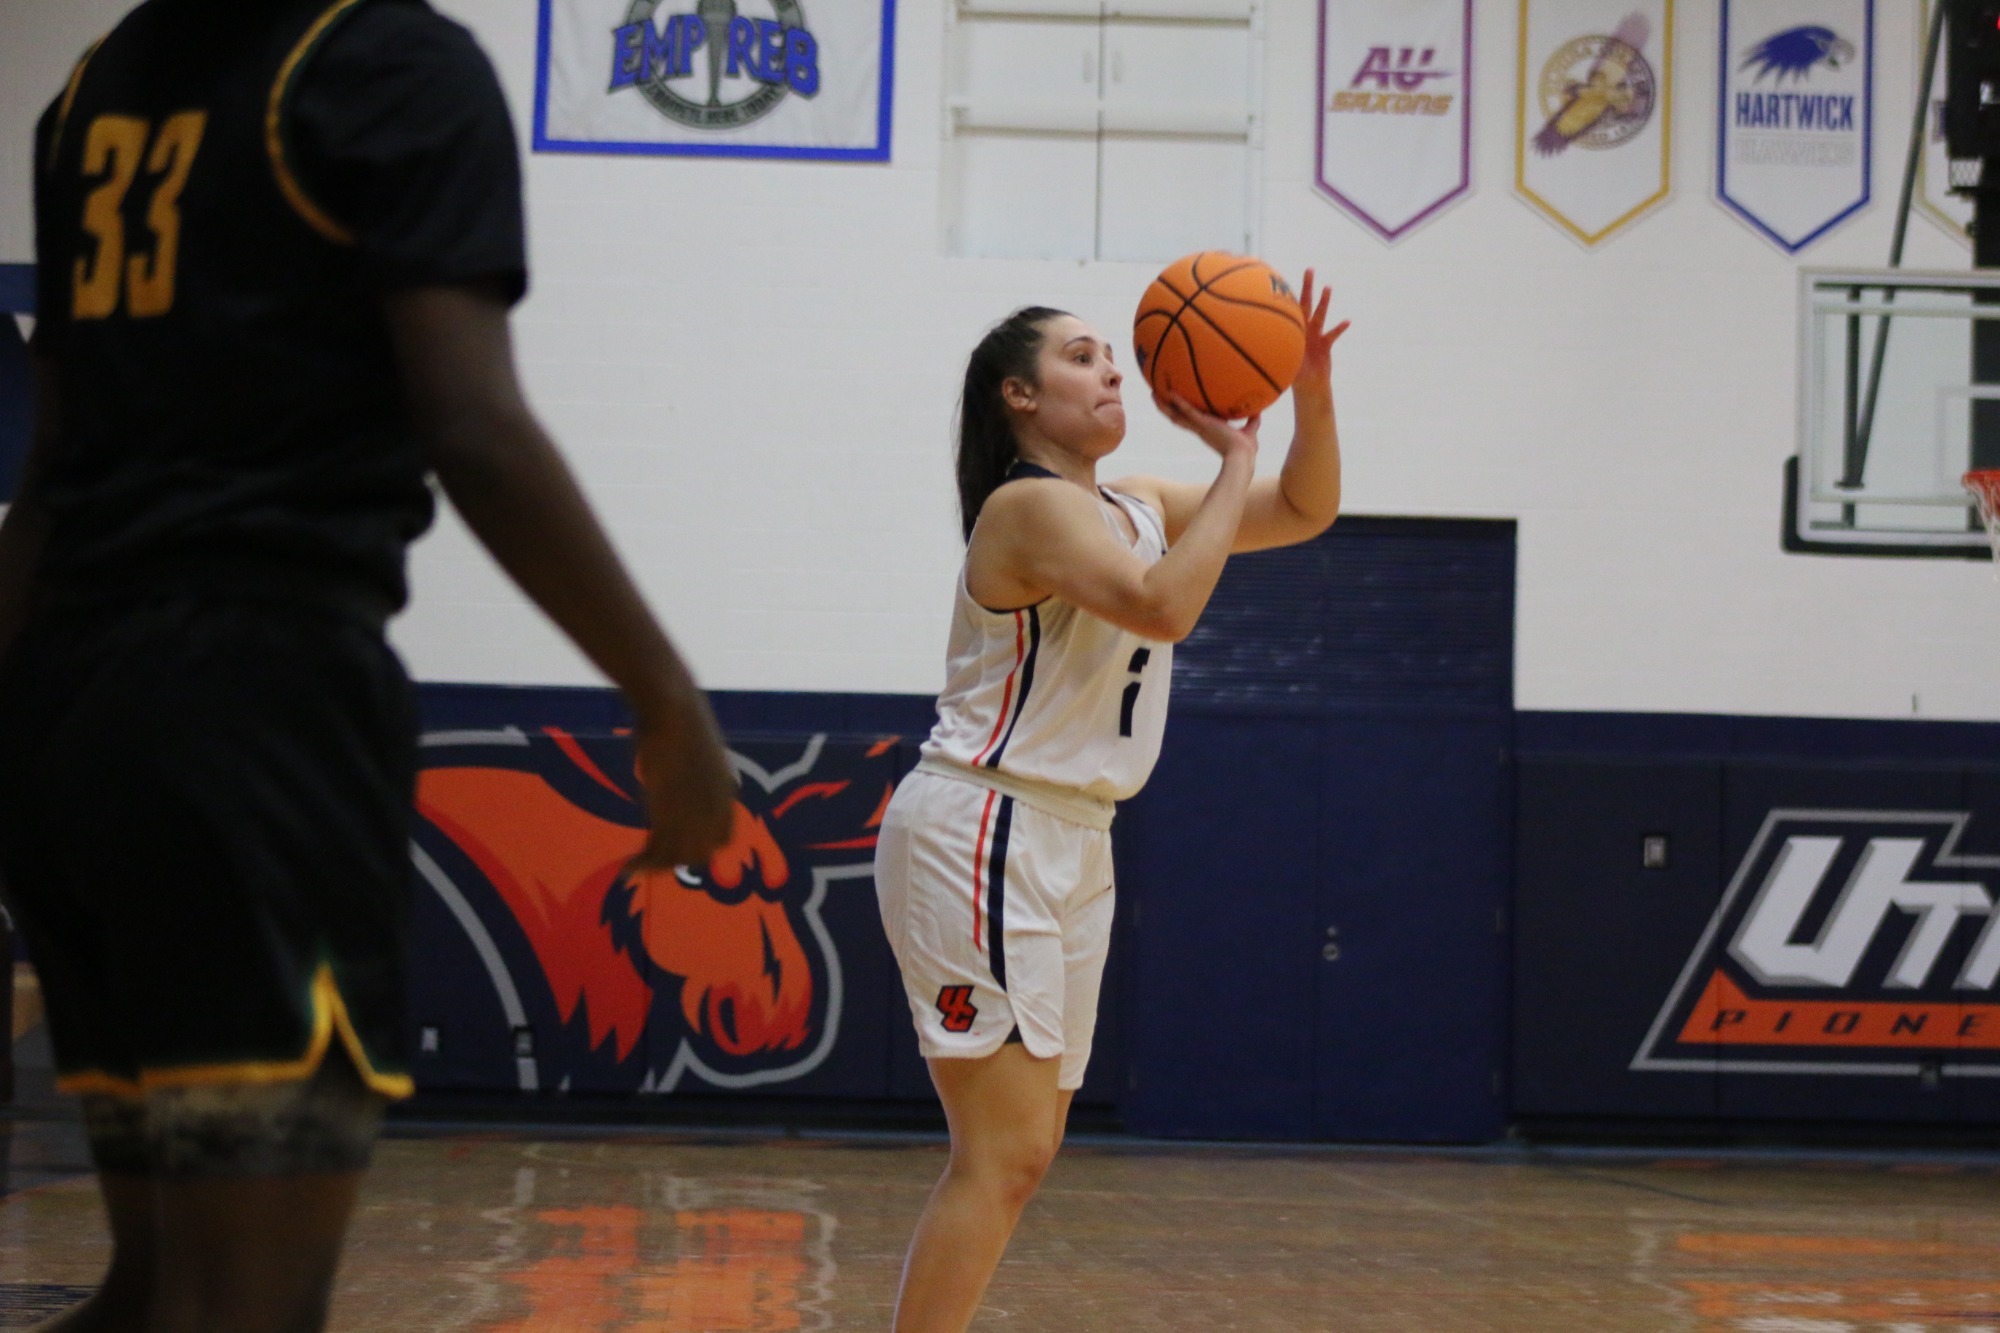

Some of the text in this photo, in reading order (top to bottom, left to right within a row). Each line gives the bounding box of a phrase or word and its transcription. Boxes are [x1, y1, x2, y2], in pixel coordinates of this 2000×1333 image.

[1349, 46, 1440, 92] AU
[1736, 92, 1854, 131] HARTWICK
[71, 108, 208, 321] 33
